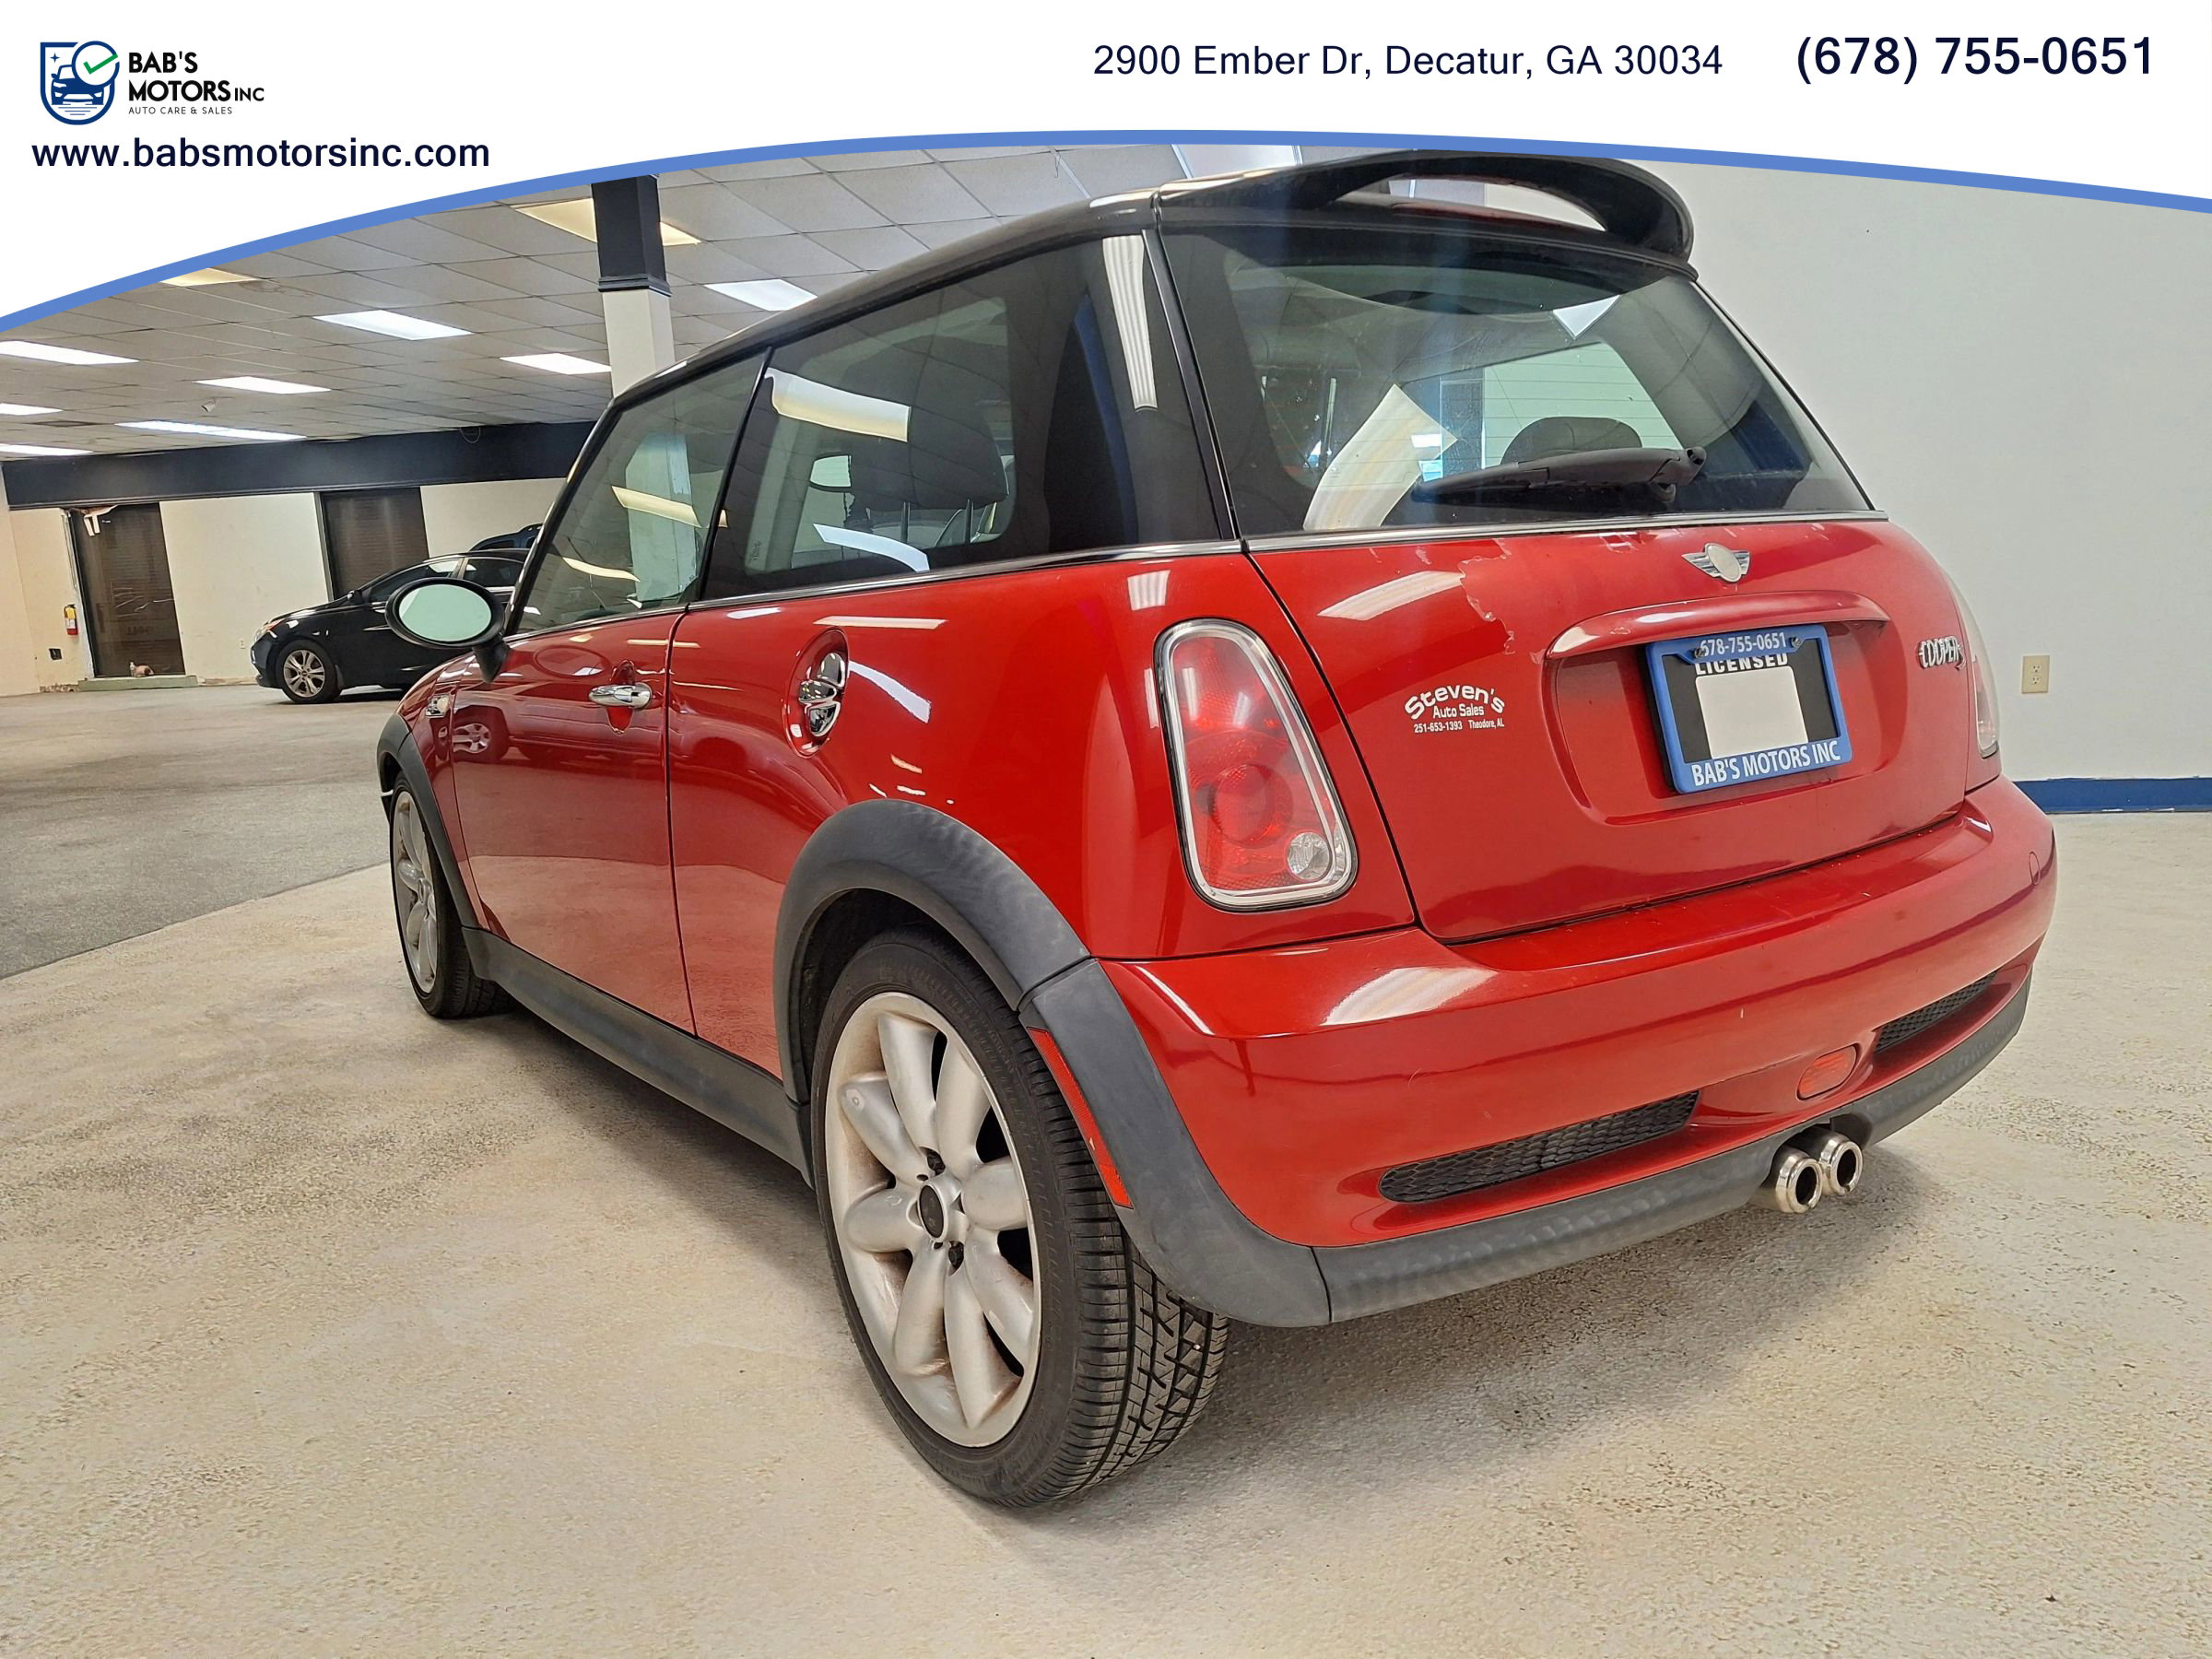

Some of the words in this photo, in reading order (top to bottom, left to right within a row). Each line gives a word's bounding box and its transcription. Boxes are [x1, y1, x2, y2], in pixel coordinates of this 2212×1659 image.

[1700, 632, 1786, 656] 678-755-0651
[1695, 653, 1788, 675] LICENSED
[1405, 685, 1504, 720] Steven's
[1433, 706, 1457, 719] Auto
[1459, 703, 1484, 717] Sales
[1414, 721, 1463, 733] 251-653-1393
[1468, 719, 1496, 729] Theodore,
[1497, 718, 1504, 727] AL
[1691, 760, 1740, 786] BAB'S
[1743, 747, 1810, 777] MOTORS
[1814, 741, 1841, 764] INC
